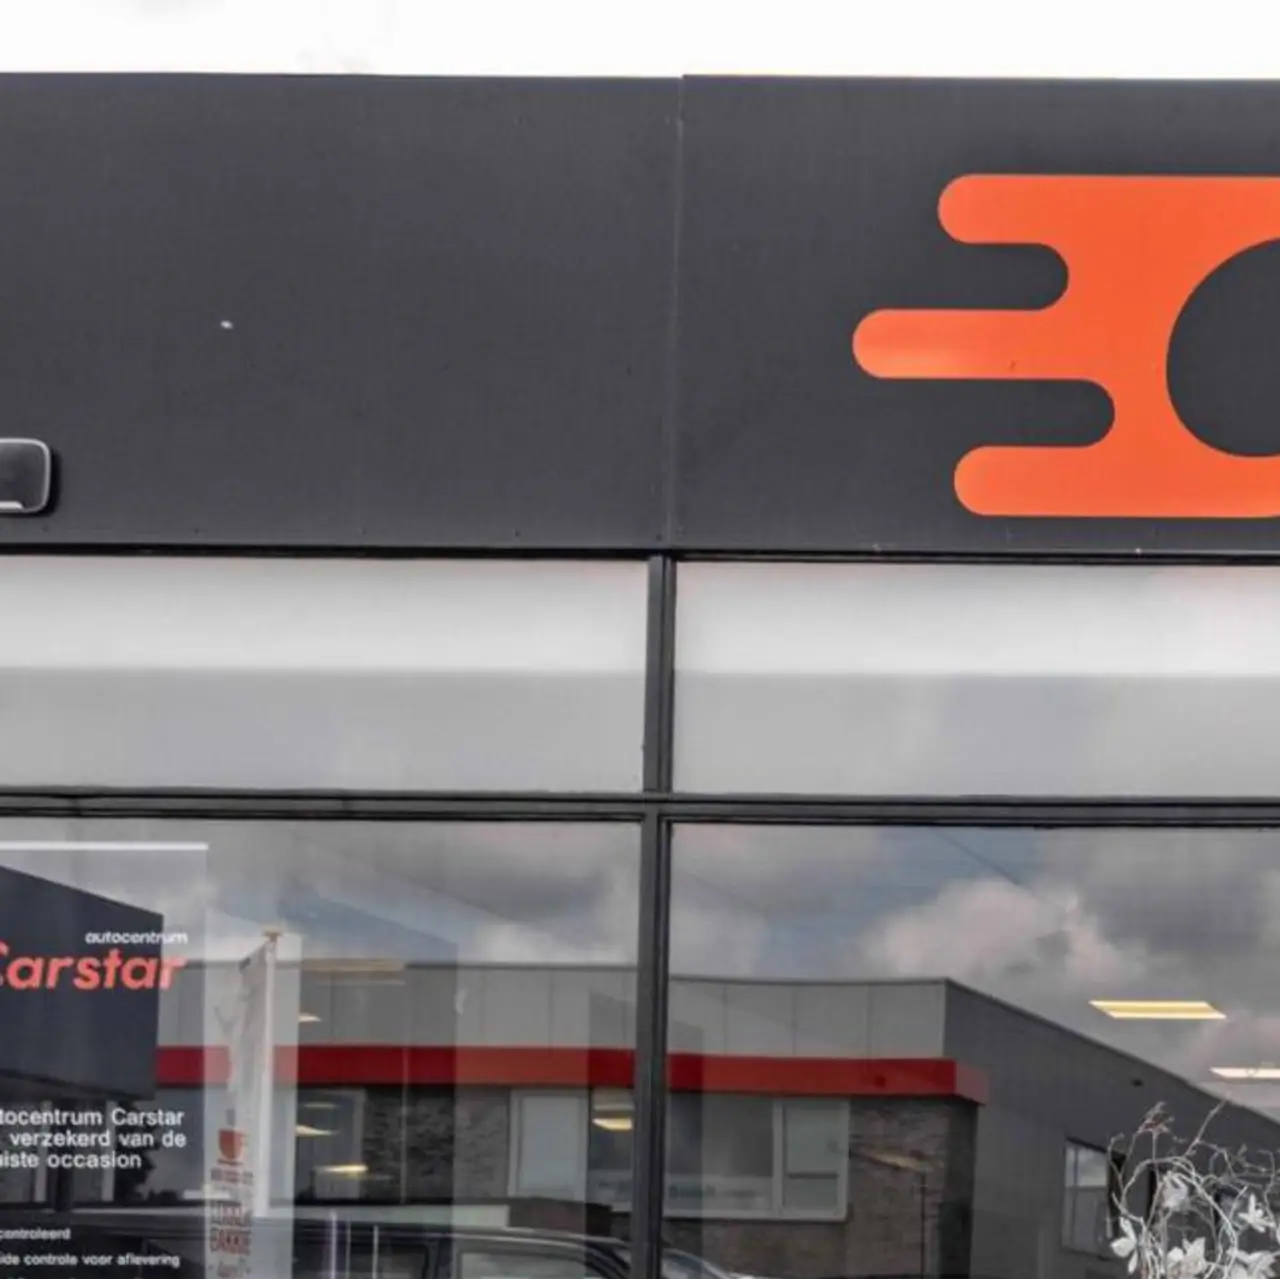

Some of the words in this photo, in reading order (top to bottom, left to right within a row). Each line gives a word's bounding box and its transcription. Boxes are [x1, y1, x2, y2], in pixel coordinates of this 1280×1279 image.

[84, 931, 188, 945] autocentrum
[0, 940, 188, 990] arstar
[111, 1108, 185, 1126] Carstar
[9, 1130, 112, 1147] verzekerd
[118, 1132, 154, 1147] van
[161, 1130, 188, 1147] de
[47, 1151, 142, 1168] occasion
[23, 1252, 78, 1266] controle
[82, 1255, 112, 1266] voor
[117, 1253, 181, 1269] aflevering
